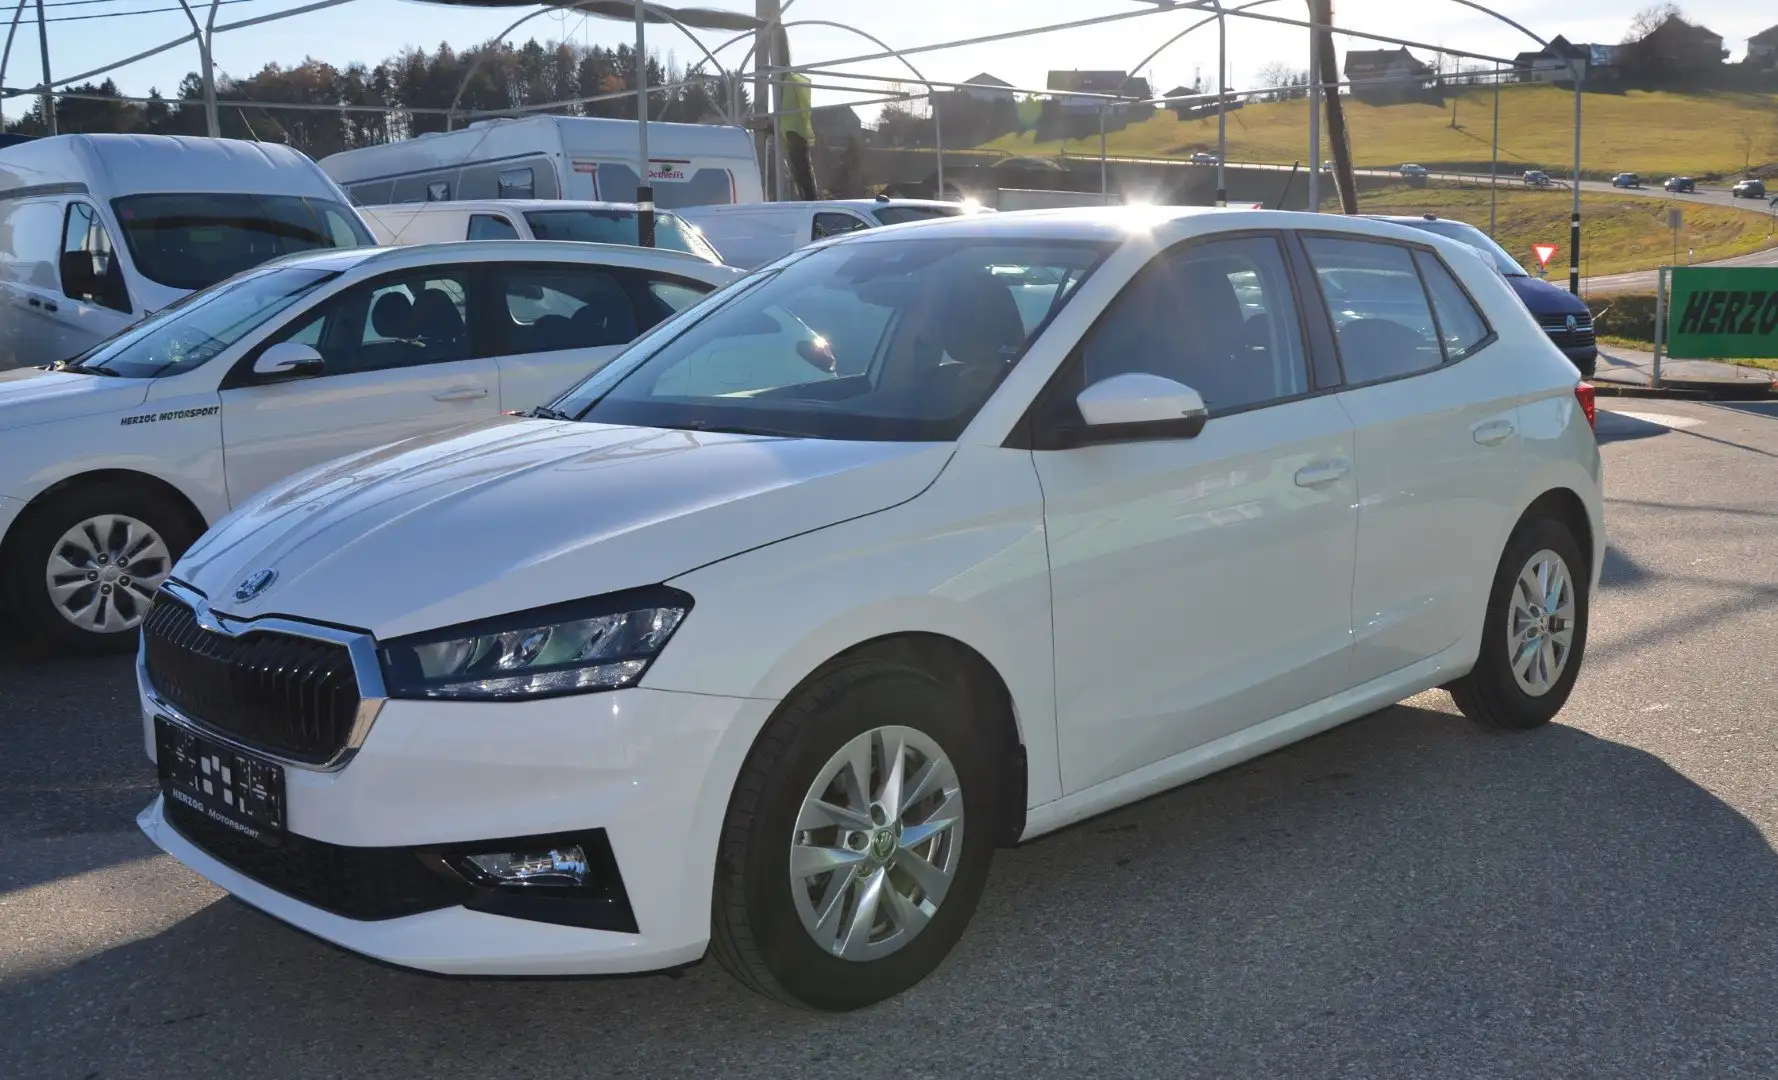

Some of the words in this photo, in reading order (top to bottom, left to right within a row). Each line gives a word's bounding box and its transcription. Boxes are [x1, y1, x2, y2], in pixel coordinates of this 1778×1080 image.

[120, 413, 157, 426] HERZOG
[158, 406, 219, 422] MOTORSPORT
[172, 787, 204, 812] HERZOG
[208, 808, 260, 839] MOTORSPORT
